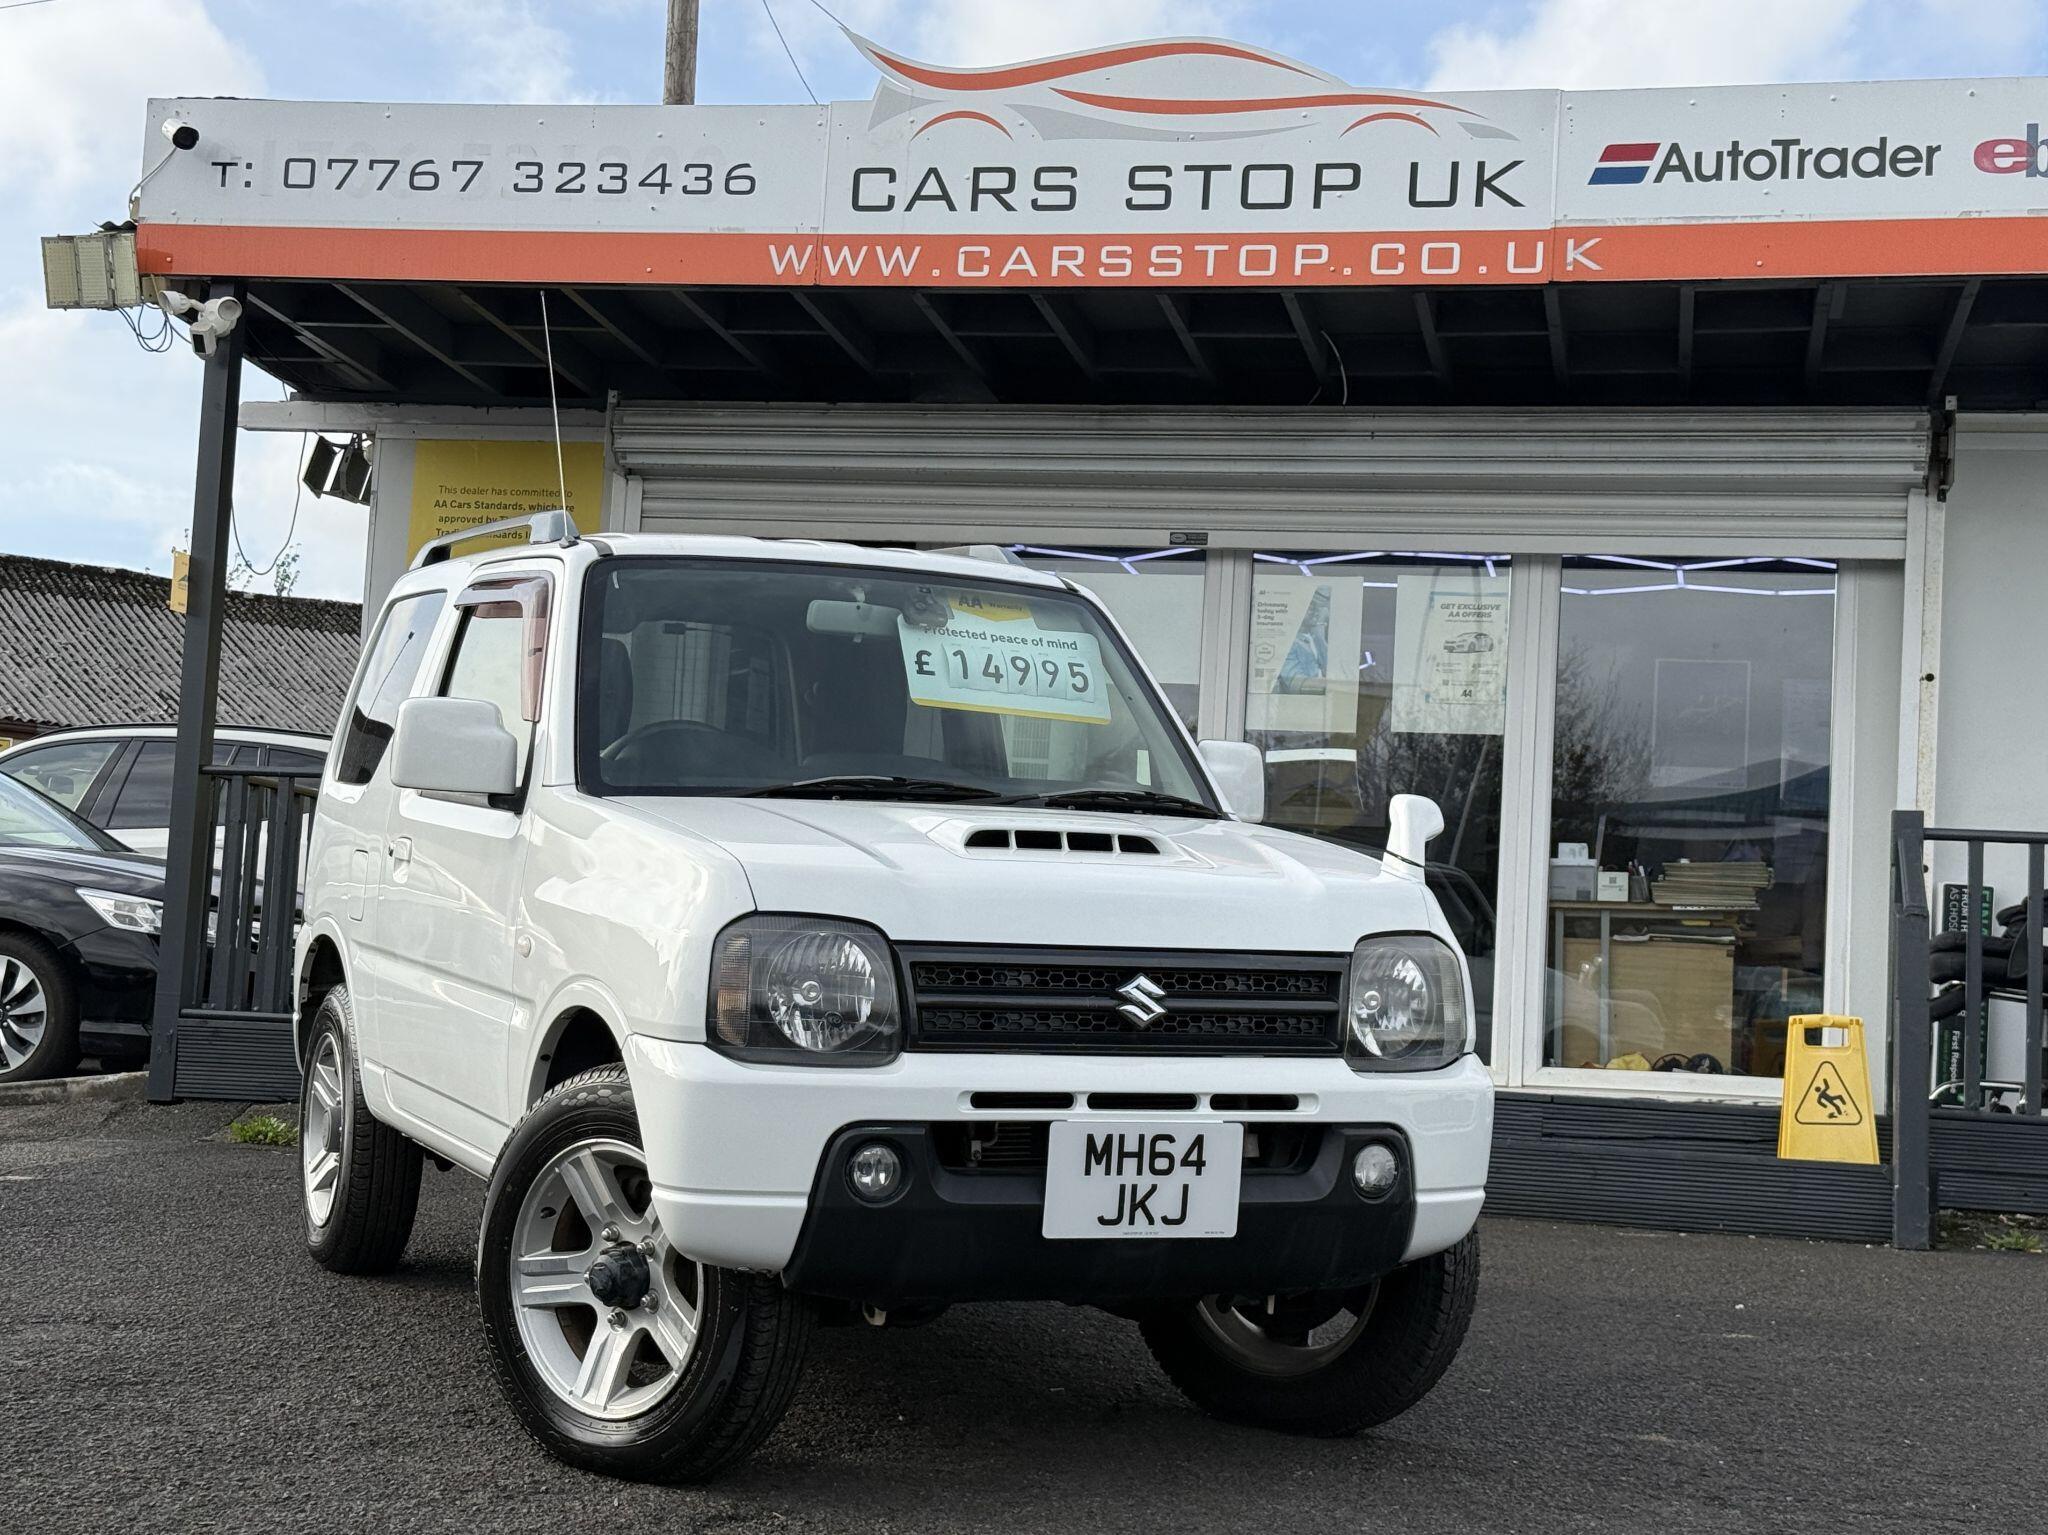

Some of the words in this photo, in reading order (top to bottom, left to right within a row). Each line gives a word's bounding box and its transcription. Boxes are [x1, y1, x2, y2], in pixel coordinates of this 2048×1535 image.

[1654, 136, 1942, 184] AutoTrader
[210, 161, 253, 188] T:
[283, 157, 484, 193] 07767
[513, 161, 756, 196] 323436
[851, 166, 1078, 212] CARS
[1125, 162, 1362, 211] STOP
[1408, 160, 1525, 208] UK
[768, 237, 1604, 277] WWW.CARSSTOP.CO.UK
[438, 485, 457, 494] This
[460, 486, 488, 495] dealer
[491, 486, 508, 496] has
[510, 487, 561, 497] committed
[434, 500, 448, 509] AA
[449, 500, 472, 509] Cars
[474, 501, 526, 511] Standards,
[528, 502, 557, 511] which
[438, 515, 483, 524] approved
[958, 595, 984, 609] AA
[1457, 603, 1501, 611] EXCLUSIVE
[991, 633, 1029, 647] peace
[1032, 637, 1044, 648] of
[1047, 639, 1078, 651] mind
[1084, 1133, 1207, 1177] MH64
[1096, 1183, 1190, 1227] JKJ
